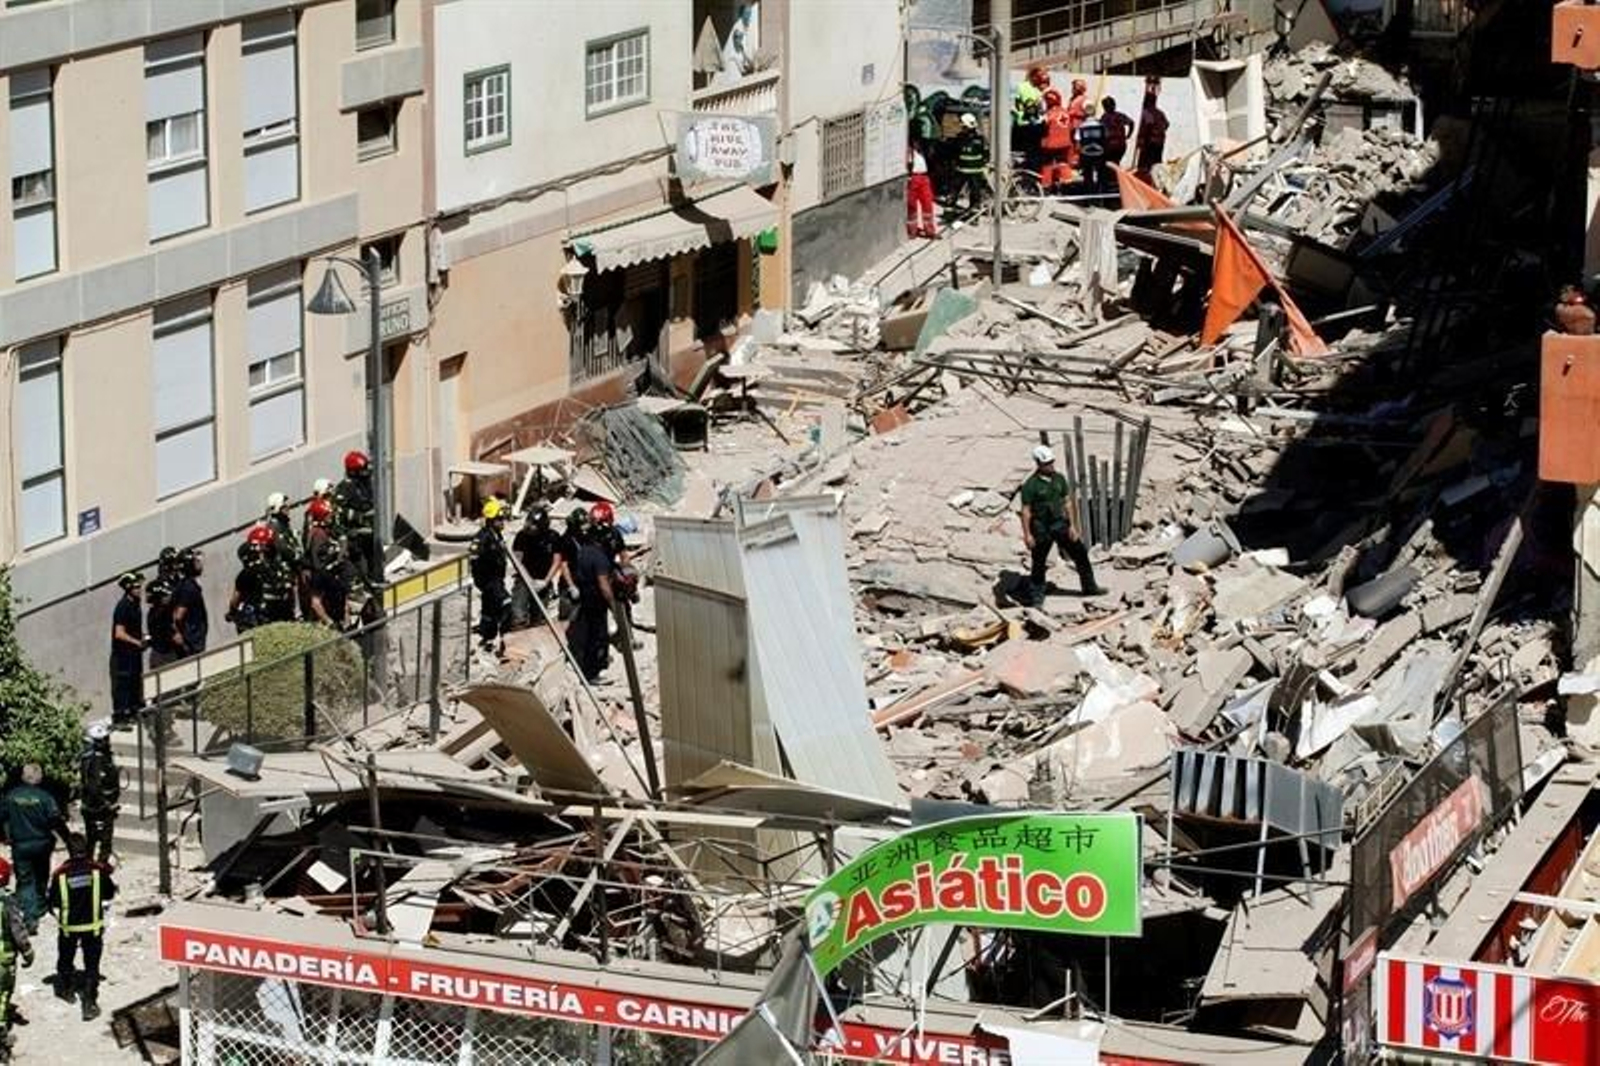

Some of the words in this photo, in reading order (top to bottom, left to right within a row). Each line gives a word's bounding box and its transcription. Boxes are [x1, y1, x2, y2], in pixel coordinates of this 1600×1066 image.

[843, 853, 1108, 945] Asiático
[184, 939, 378, 985] PANADERÍA
[410, 970, 585, 1015] FRUTERÍA
